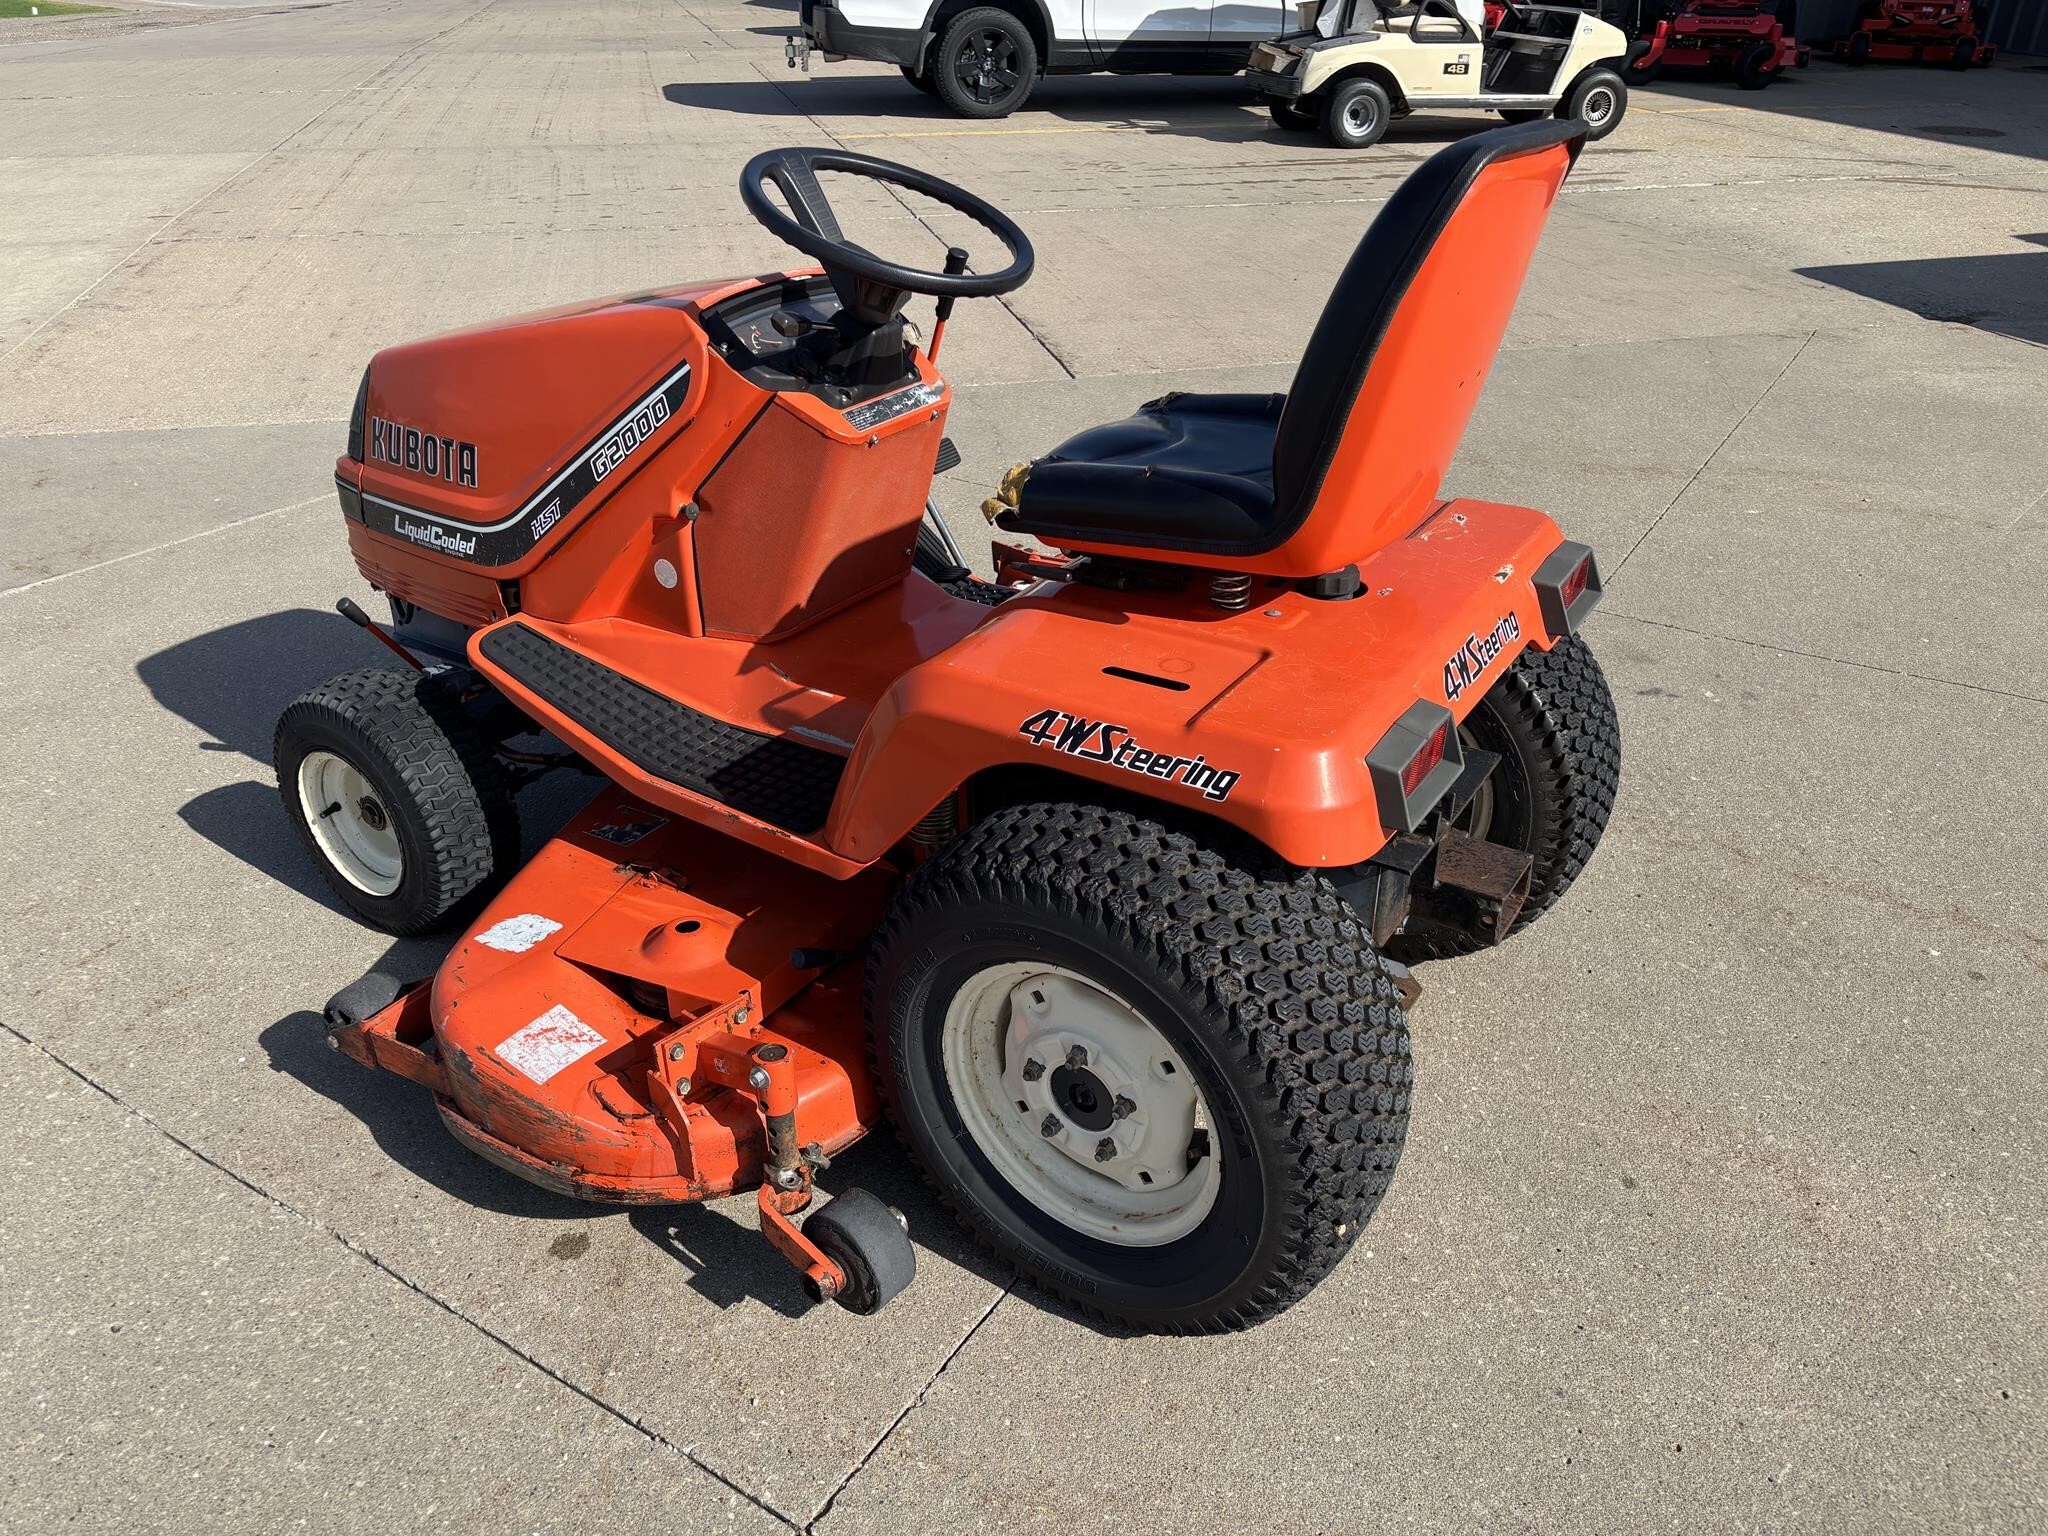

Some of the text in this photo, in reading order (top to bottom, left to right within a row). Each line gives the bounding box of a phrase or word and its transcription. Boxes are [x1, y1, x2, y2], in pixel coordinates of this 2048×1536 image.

[1698, 18, 1757, 26] GRAVELY
[1447, 63, 1466, 74] 48
[370, 415, 479, 489] KUBOTA
[590, 393, 671, 482] G2000
[394, 513, 477, 556] LiquidCooled
[530, 496, 561, 541] HST
[1442, 610, 1521, 703] 4WSteering
[1018, 708, 1241, 803] 4WSteering
